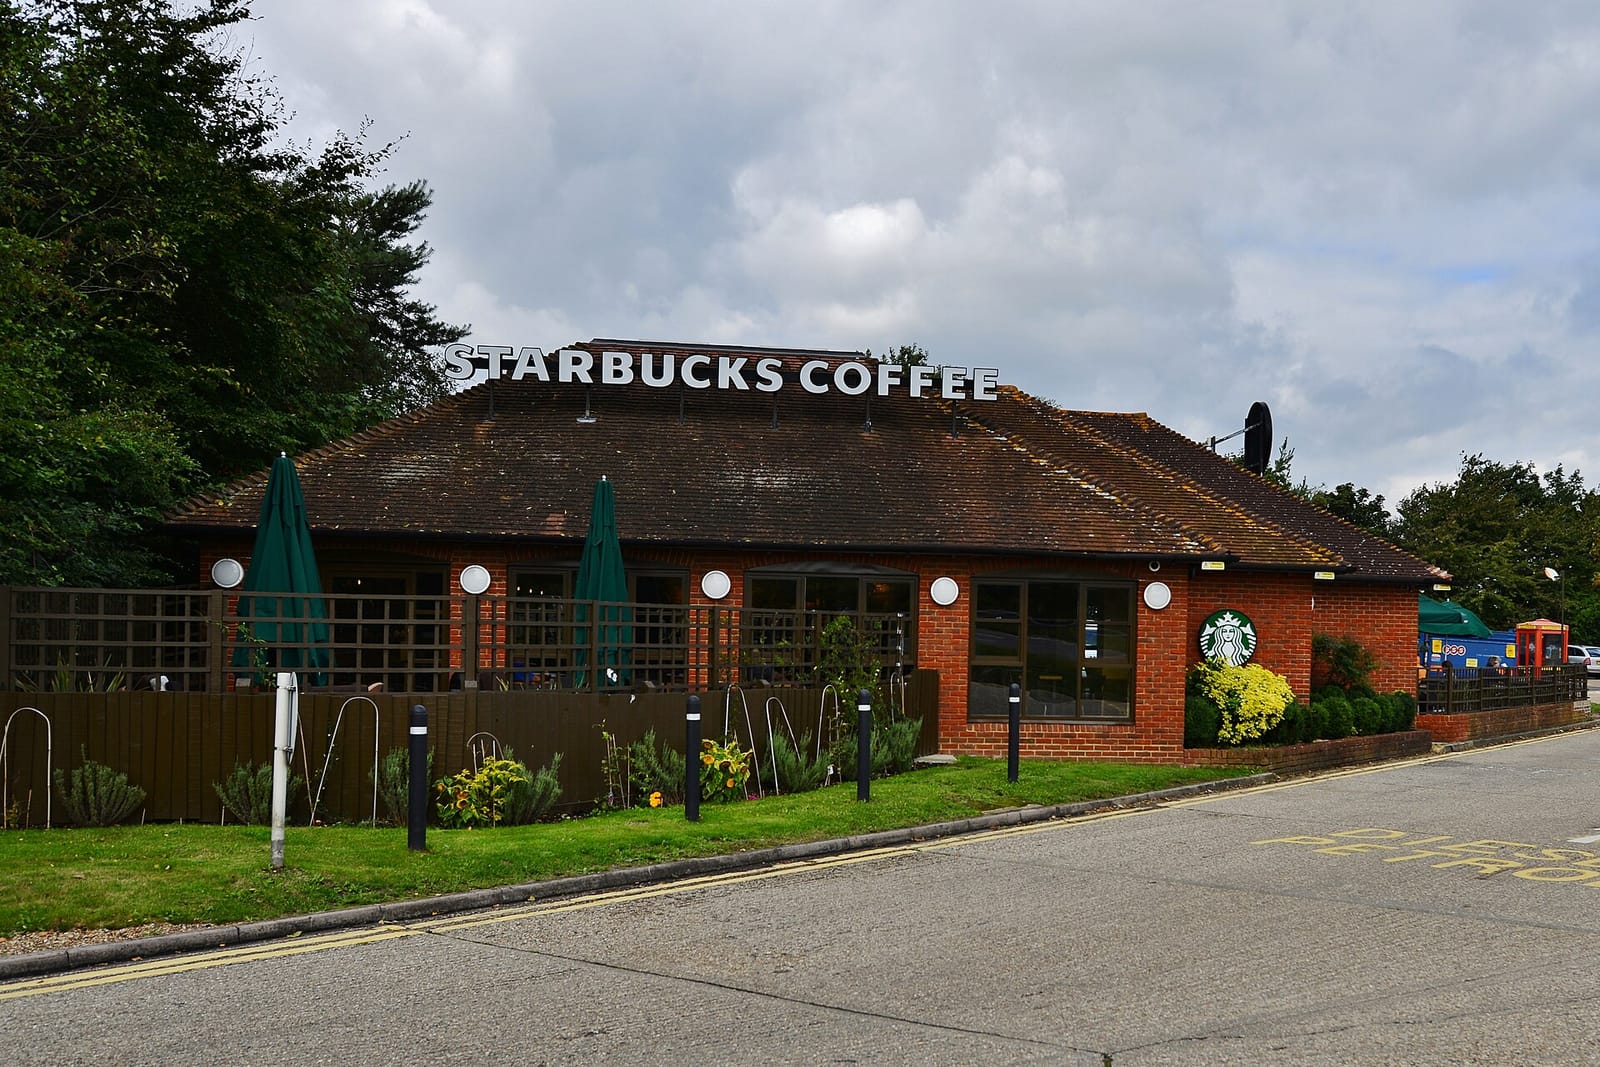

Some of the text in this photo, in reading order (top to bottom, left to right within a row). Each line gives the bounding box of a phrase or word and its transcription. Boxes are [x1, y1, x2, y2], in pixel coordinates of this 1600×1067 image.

[443, 343, 999, 401] STARBUCKS COFFEE
[1249, 836, 1600, 888] PETRO
